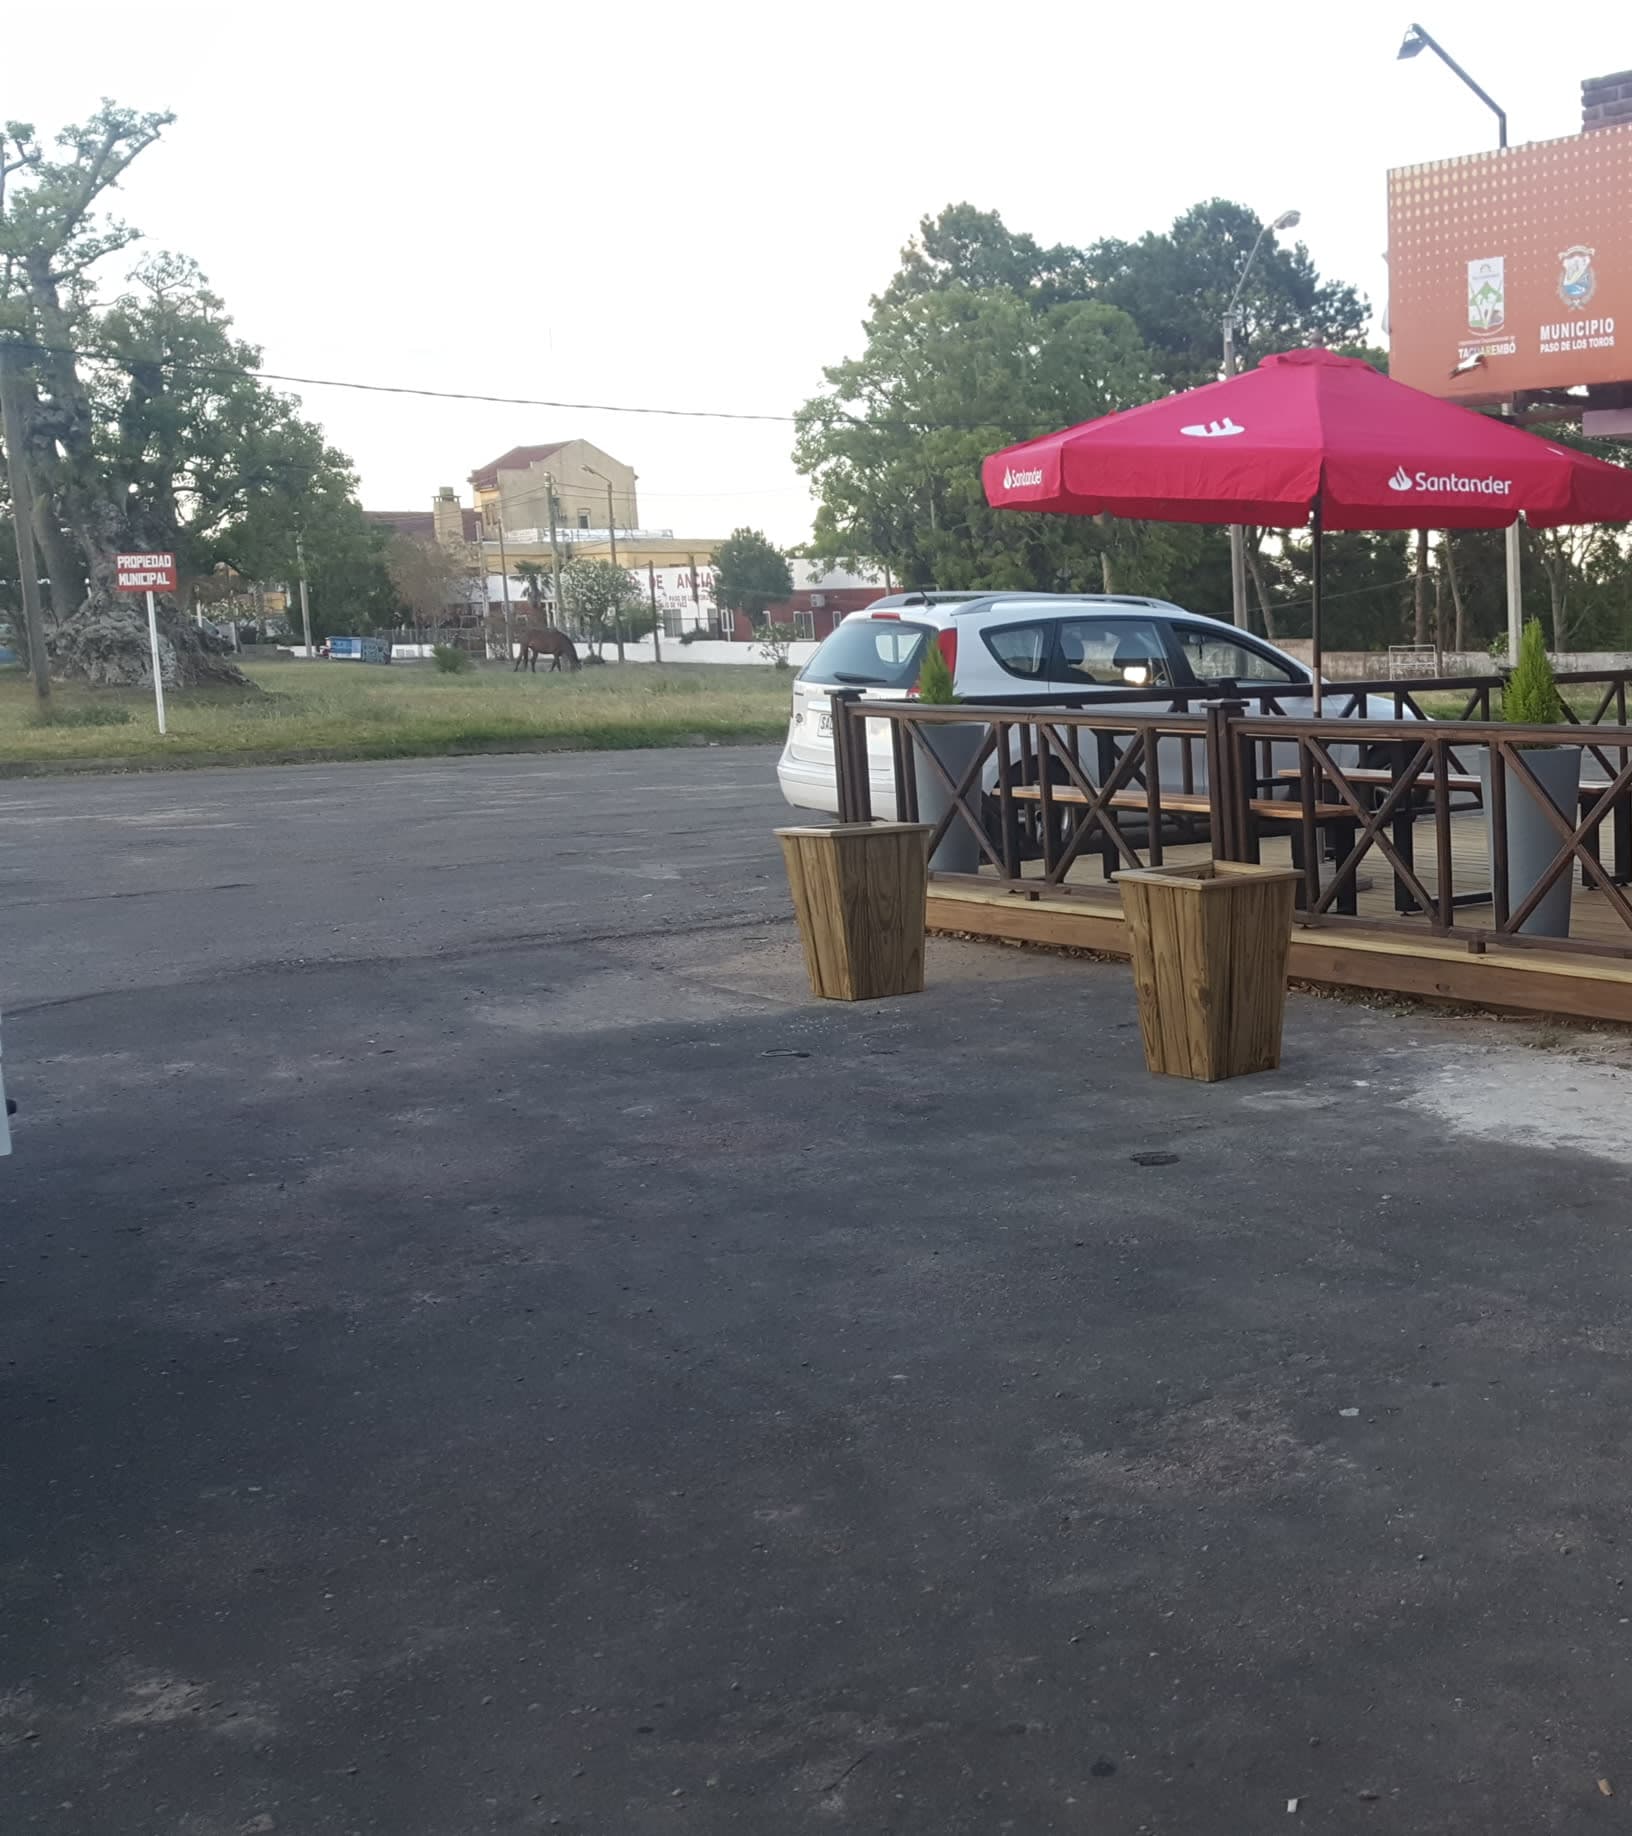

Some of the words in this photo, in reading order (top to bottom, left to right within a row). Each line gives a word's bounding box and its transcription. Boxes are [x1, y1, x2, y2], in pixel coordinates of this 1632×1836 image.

[1540, 317, 1614, 340] MUNICIPIO
[1540, 342, 1560, 353] PASO
[1561, 340, 1571, 351] DE
[1572, 339, 1587, 349] LOS
[1588, 336, 1614, 347] TOROS
[1415, 472, 1512, 495] Santander
[117, 555, 171, 568] PROPIEDAD
[118, 572, 170, 585] MUNICIPAL
